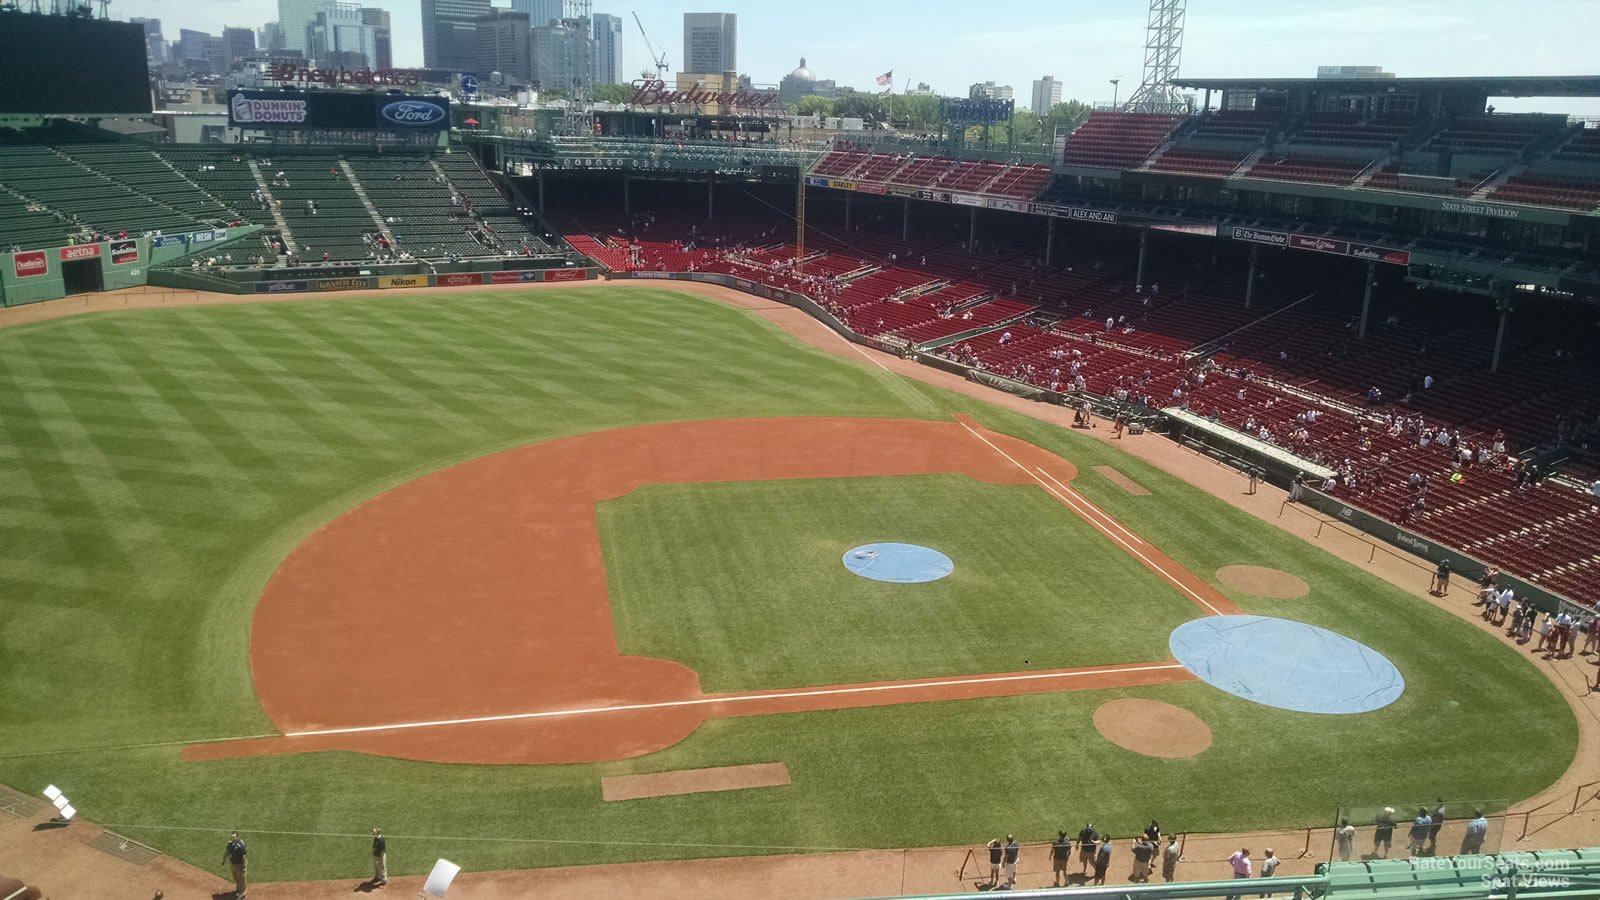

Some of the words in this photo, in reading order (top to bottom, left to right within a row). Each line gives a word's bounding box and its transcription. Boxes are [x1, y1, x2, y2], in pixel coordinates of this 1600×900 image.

[299, 69, 336, 84] new
[340, 66, 418, 85] balance
[632, 79, 777, 106] Budweiser
[253, 101, 306, 111] DUNKIN'
[255, 111, 304, 122] DONUTS
[395, 104, 433, 121] Ford
[833, 181, 852, 189] STANLEY
[1442, 201, 1461, 211] STATE
[1461, 203, 1485, 215] STREET
[1485, 206, 1519, 218] PAVILION
[1072, 209, 1088, 218] ALEX
[1088, 211, 1103, 220] AND
[1103, 212, 1115, 222] ANI
[1243, 230, 1253, 239] The
[1253, 232, 1271, 242] Boston
[1270, 233, 1285, 244] Globe
[1300, 239, 1315, 248] Ninety
[1324, 241, 1335, 250] Nine
[67, 247, 94, 258] aetna
[111, 246, 137, 256] Safelite
[1353, 249, 1379, 259] Safelite
[390, 278, 416, 287] Nikon
[447, 275, 472, 285] xfinity
